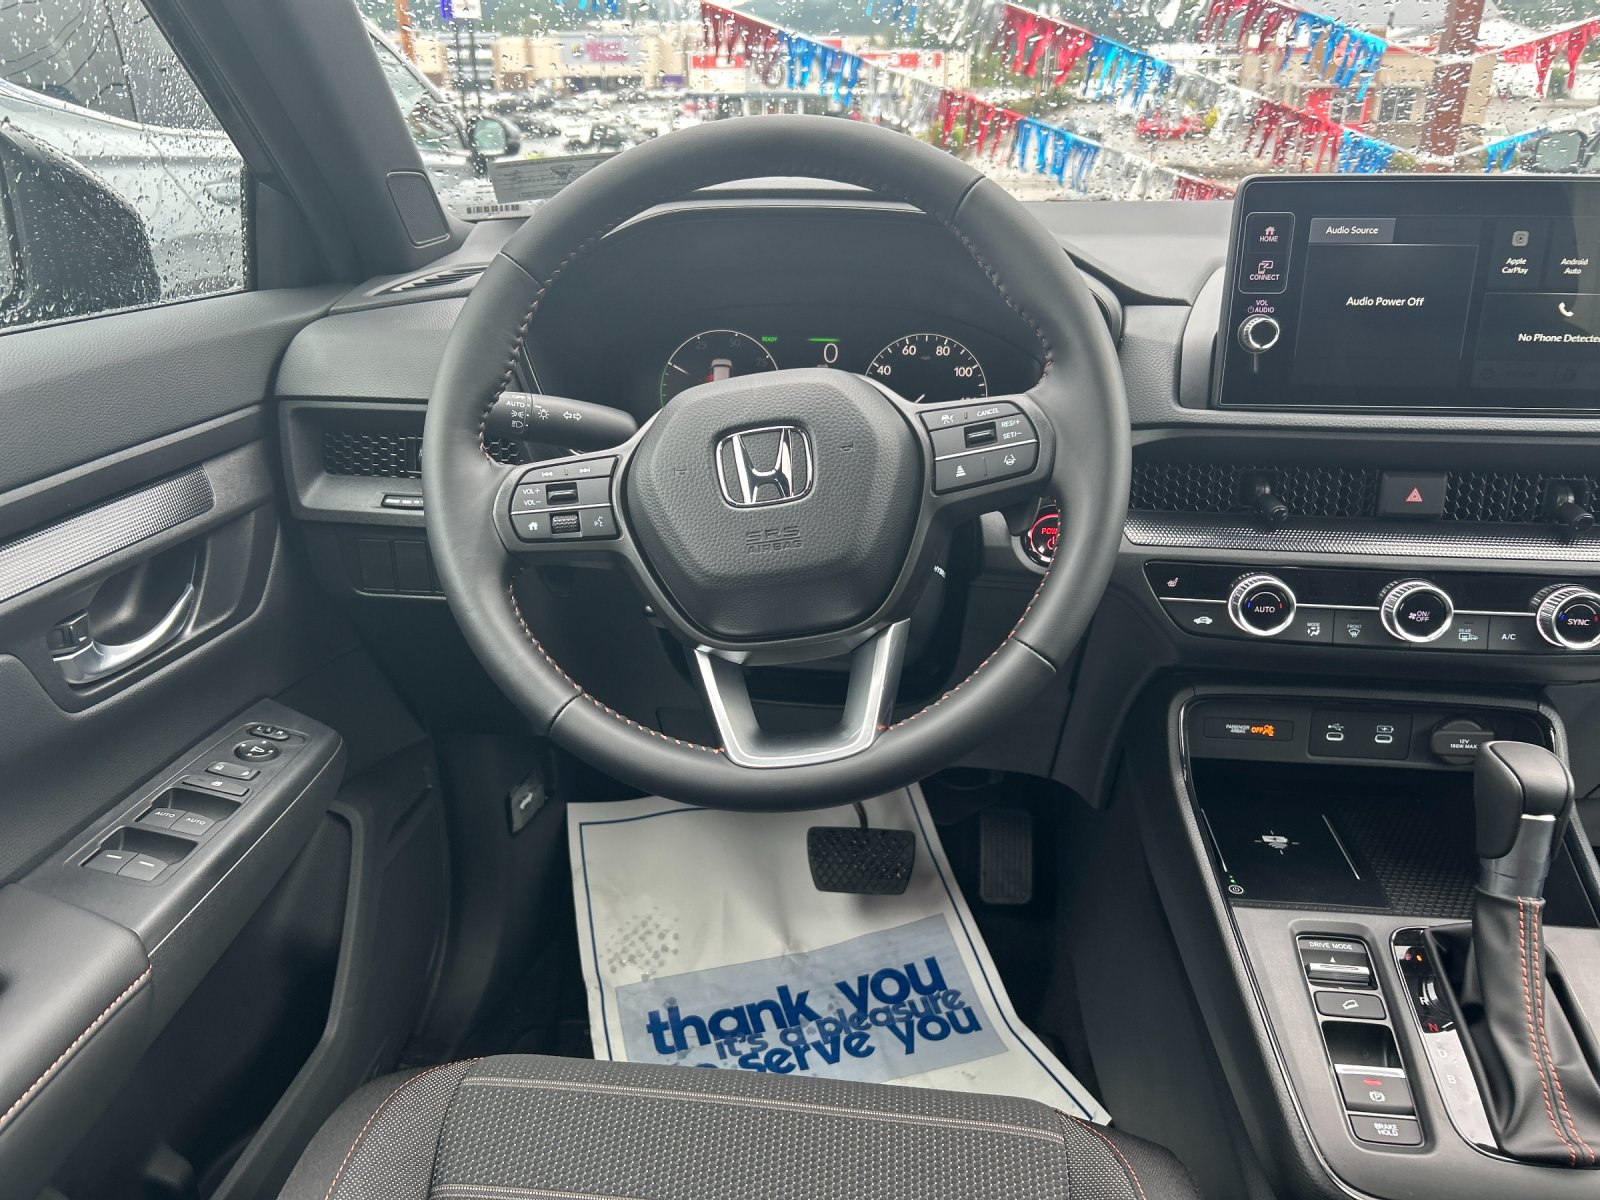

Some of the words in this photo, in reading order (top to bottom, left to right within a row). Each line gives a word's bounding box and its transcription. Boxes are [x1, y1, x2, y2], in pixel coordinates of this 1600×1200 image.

[1326, 226, 1350, 234] Audio
[1351, 226, 1379, 234] Source
[1506, 257, 1527, 266] Apple
[1561, 258, 1588, 266] Android
[1502, 267, 1529, 275] CarPlay
[1346, 297, 1374, 306] Audio
[1375, 297, 1405, 306] Power
[1407, 297, 1425, 306] Off
[1518, 333, 1532, 342] No
[1533, 334, 1562, 342] Phone
[1563, 334, 1600, 343] Detecte
[823, 343, 839, 363] 0
[902, 345, 917, 356] 60
[935, 345, 951, 356] 80
[876, 365, 892, 376] 40
[953, 366, 973, 378] 100
[506, 400, 526, 408] AUTO
[976, 407, 1000, 417] CANCEL
[745, 525, 801, 542] SRS
[1041, 527, 1058, 535] POW
[746, 540, 803, 555] AIRBAG
[1254, 605, 1276, 614] AUTO
[1567, 618, 1590, 627] SYNC
[1501, 633, 1517, 642] A/C
[1251, 726, 1264, 734] OFF
[155, 810, 176, 819] AUTO
[186, 816, 206, 826] AUTO
[1308, 941, 1331, 949] DRIVE
[1332, 942, 1353, 950] MODE
[646, 984, 822, 1055] thank
[834, 955, 948, 1021] you
[713, 1033, 769, 1061] it's
[816, 988, 966, 1045] pleasure
[1428, 1022, 1439, 1033] N
[738, 1030, 876, 1075] serve
[887, 1005, 983, 1056] you
[1374, 1122, 1398, 1131] BRAKE
[1377, 1129, 1399, 1137] HOLD
